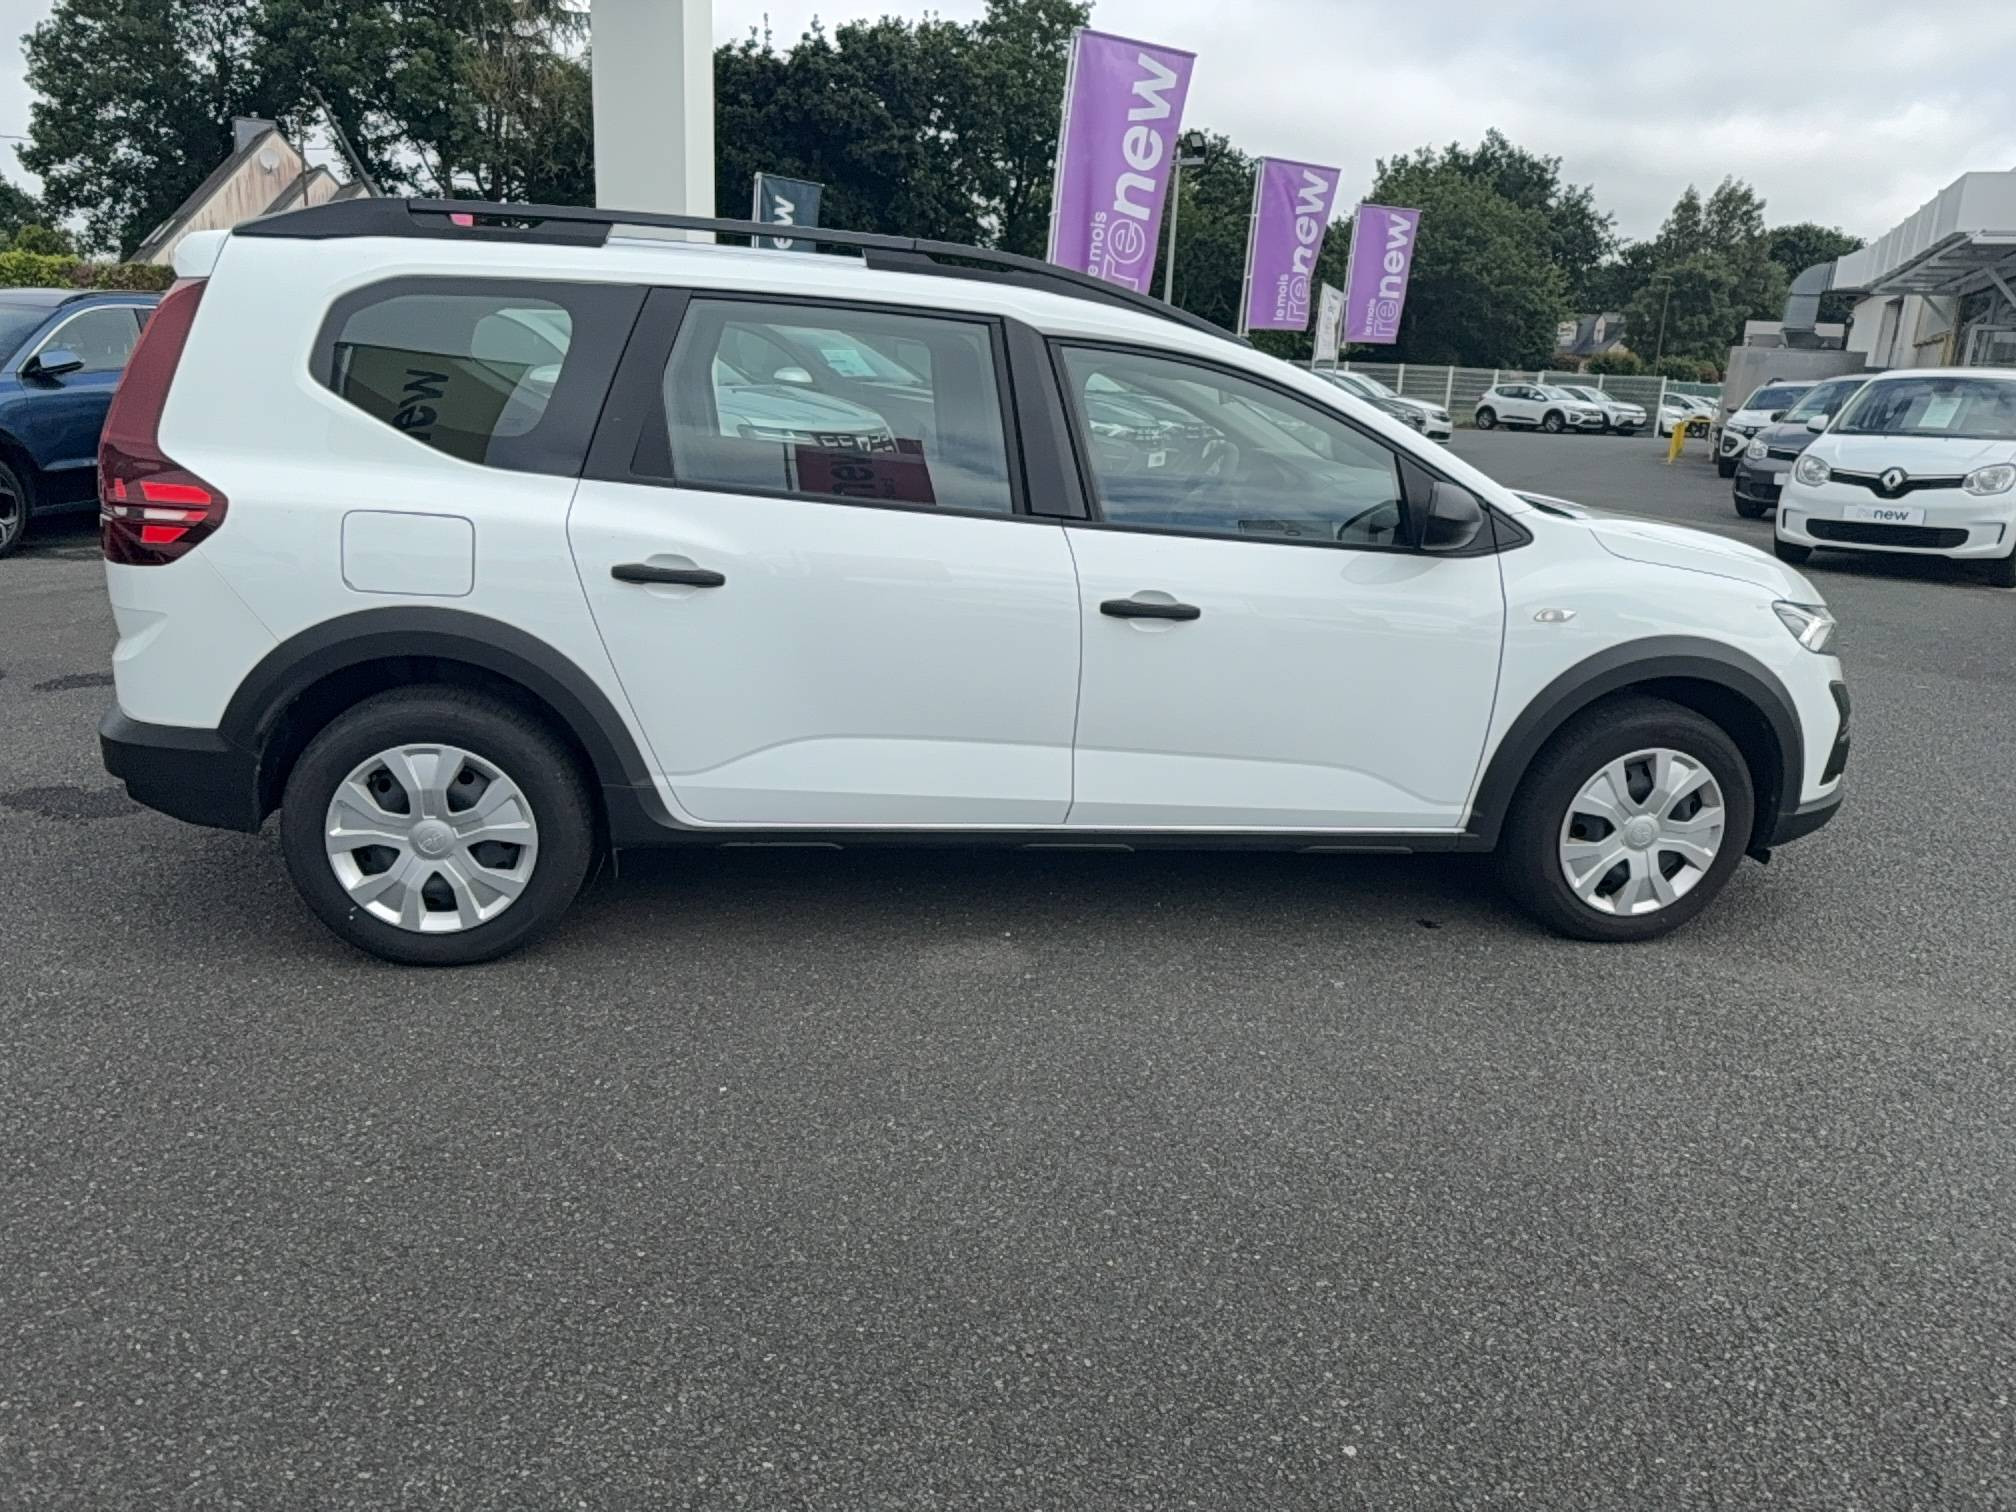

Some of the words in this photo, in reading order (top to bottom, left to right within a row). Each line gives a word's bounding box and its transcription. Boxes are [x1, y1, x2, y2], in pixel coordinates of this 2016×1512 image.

[1102, 52, 1178, 291] renew
[1089, 211, 1107, 261] mois
[1277, 273, 1289, 307] mois
[1286, 169, 1329, 322] renew
[1374, 213, 1412, 337] renew
